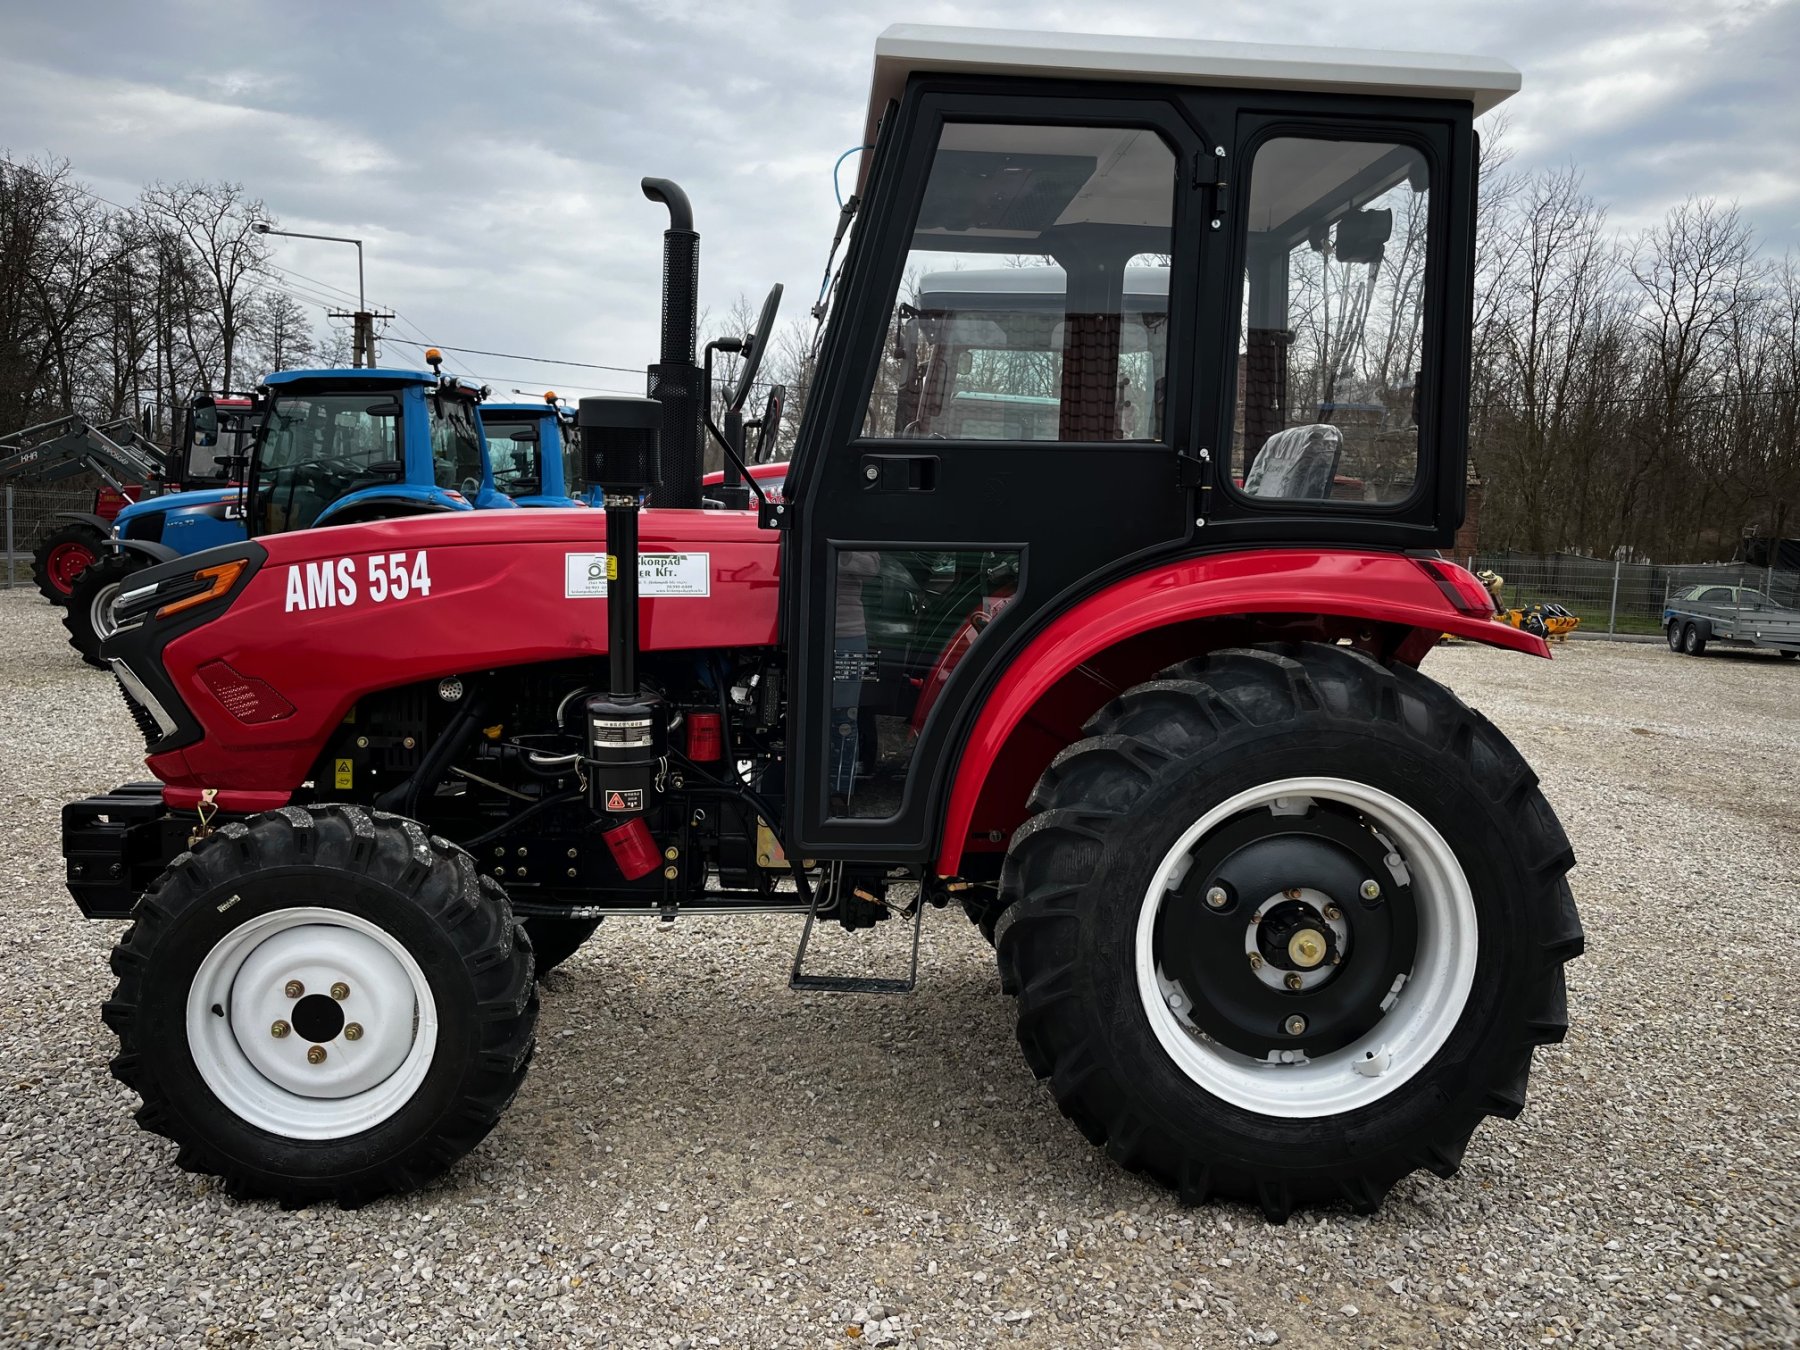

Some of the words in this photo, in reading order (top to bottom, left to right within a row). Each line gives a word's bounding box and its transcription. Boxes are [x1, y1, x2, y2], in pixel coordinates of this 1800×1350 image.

[639, 555, 681, 568] korpád
[285, 557, 357, 612] AMS
[368, 550, 431, 602] 554
